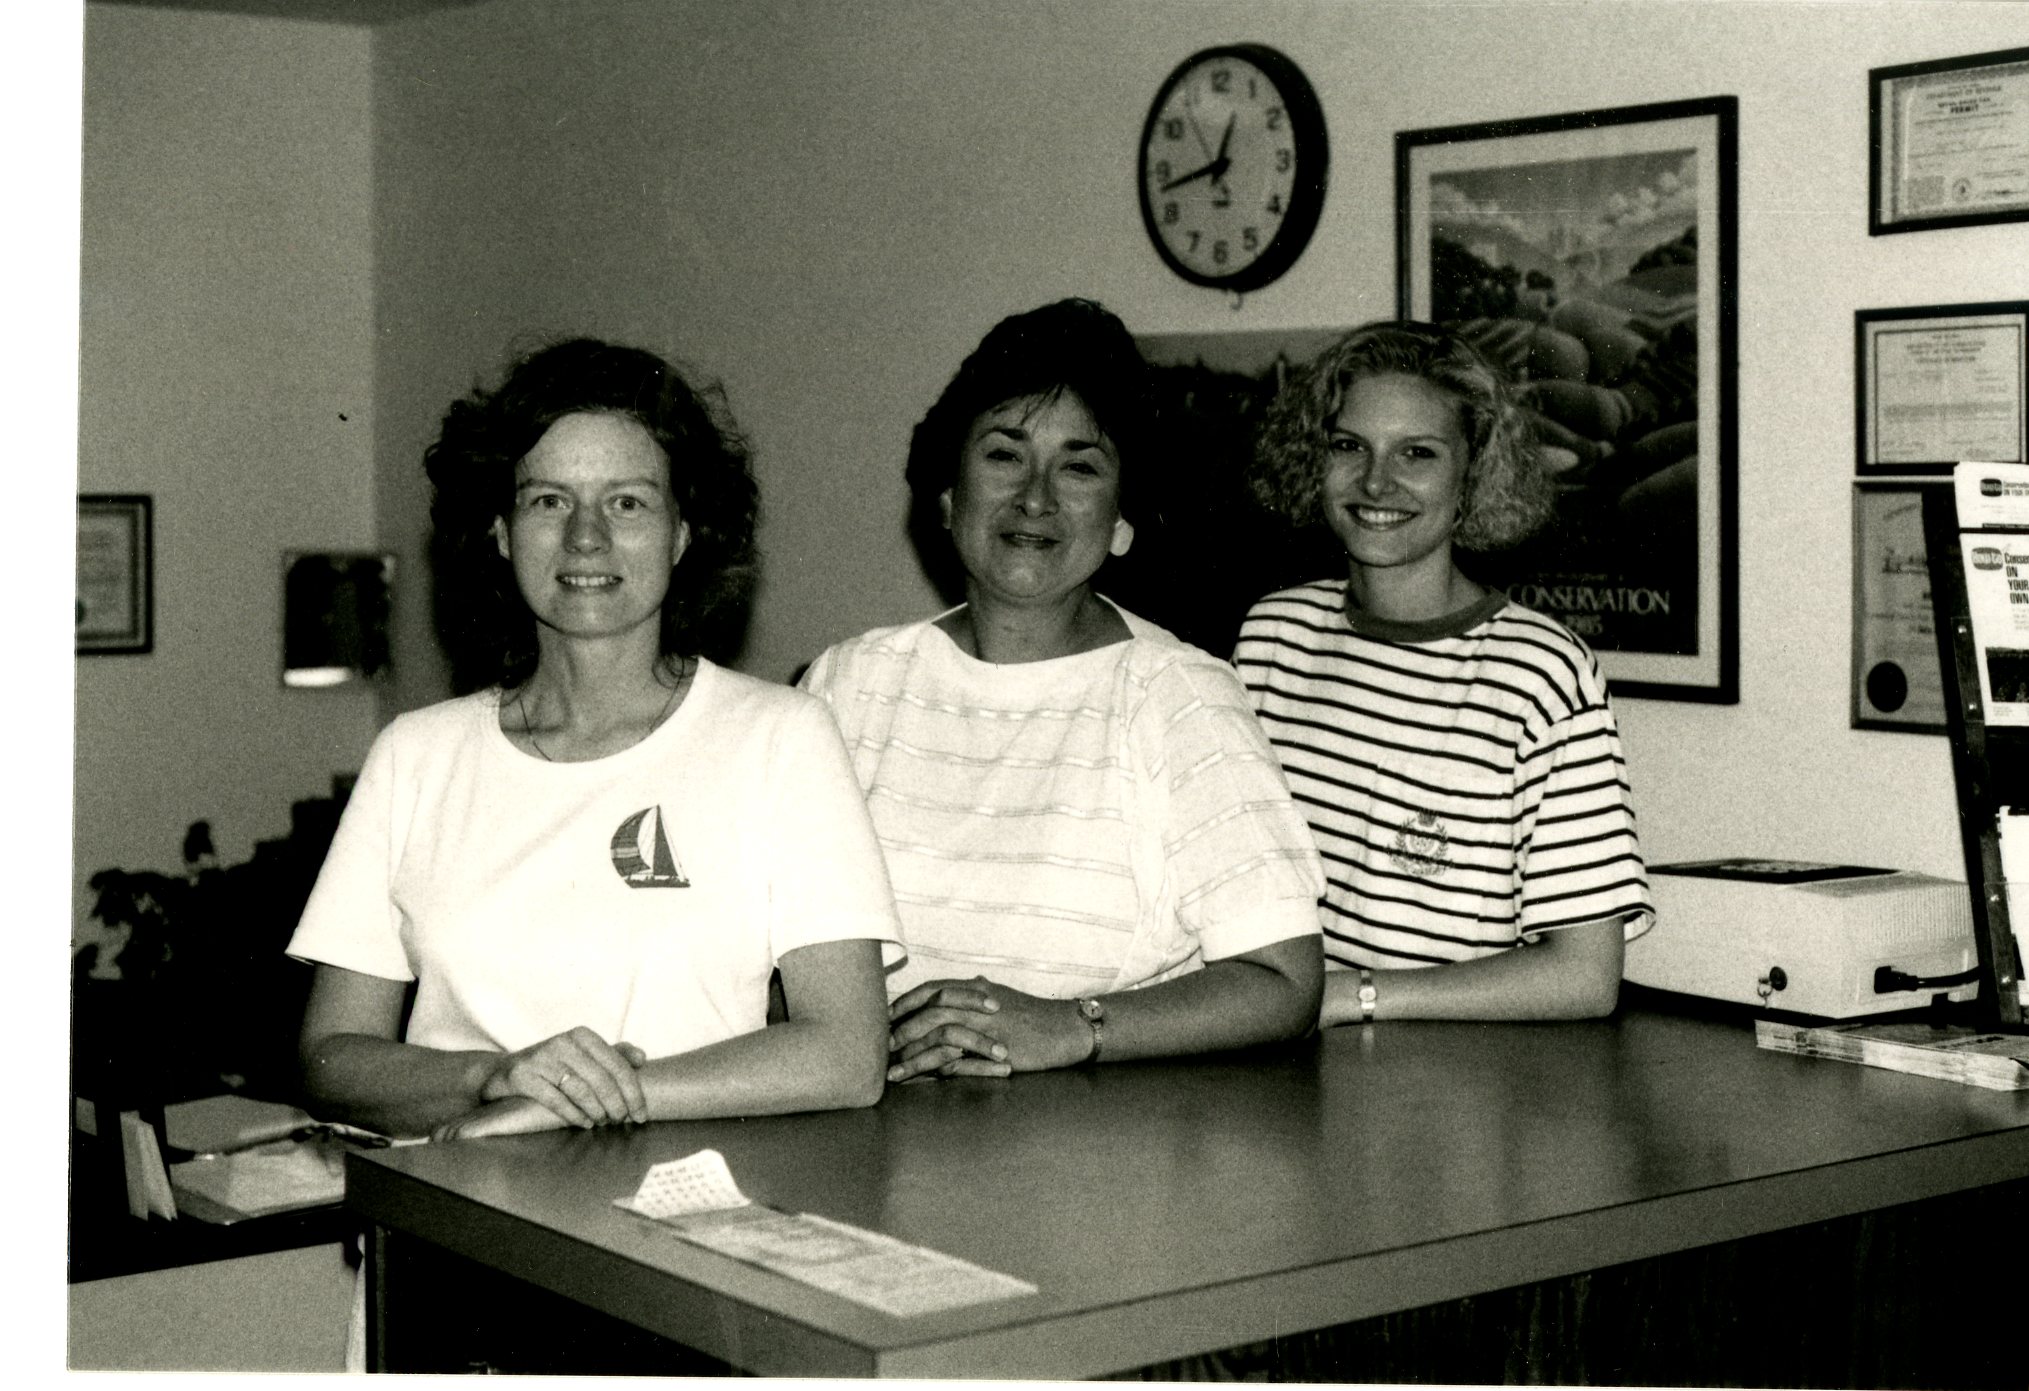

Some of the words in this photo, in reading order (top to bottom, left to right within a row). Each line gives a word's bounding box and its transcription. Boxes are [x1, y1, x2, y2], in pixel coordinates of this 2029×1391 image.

[1211, 69, 1230, 93] 12
[1249, 79, 1256, 99] 1
[1266, 106, 1281, 131] 2
[1156, 159, 1171, 183] 9
[1276, 148, 1290, 173] 3
[1164, 201, 1180, 226] 8
[1267, 193, 1282, 216] 4
[1187, 229, 1200, 253] 7
[1243, 226, 1258, 252] 5
[1212, 239, 1228, 264] 6
[2006, 566, 2018, 577] ON
[2007, 579, 2029, 590] YOUR
[1506, 583, 1671, 616] CONSERVATION
